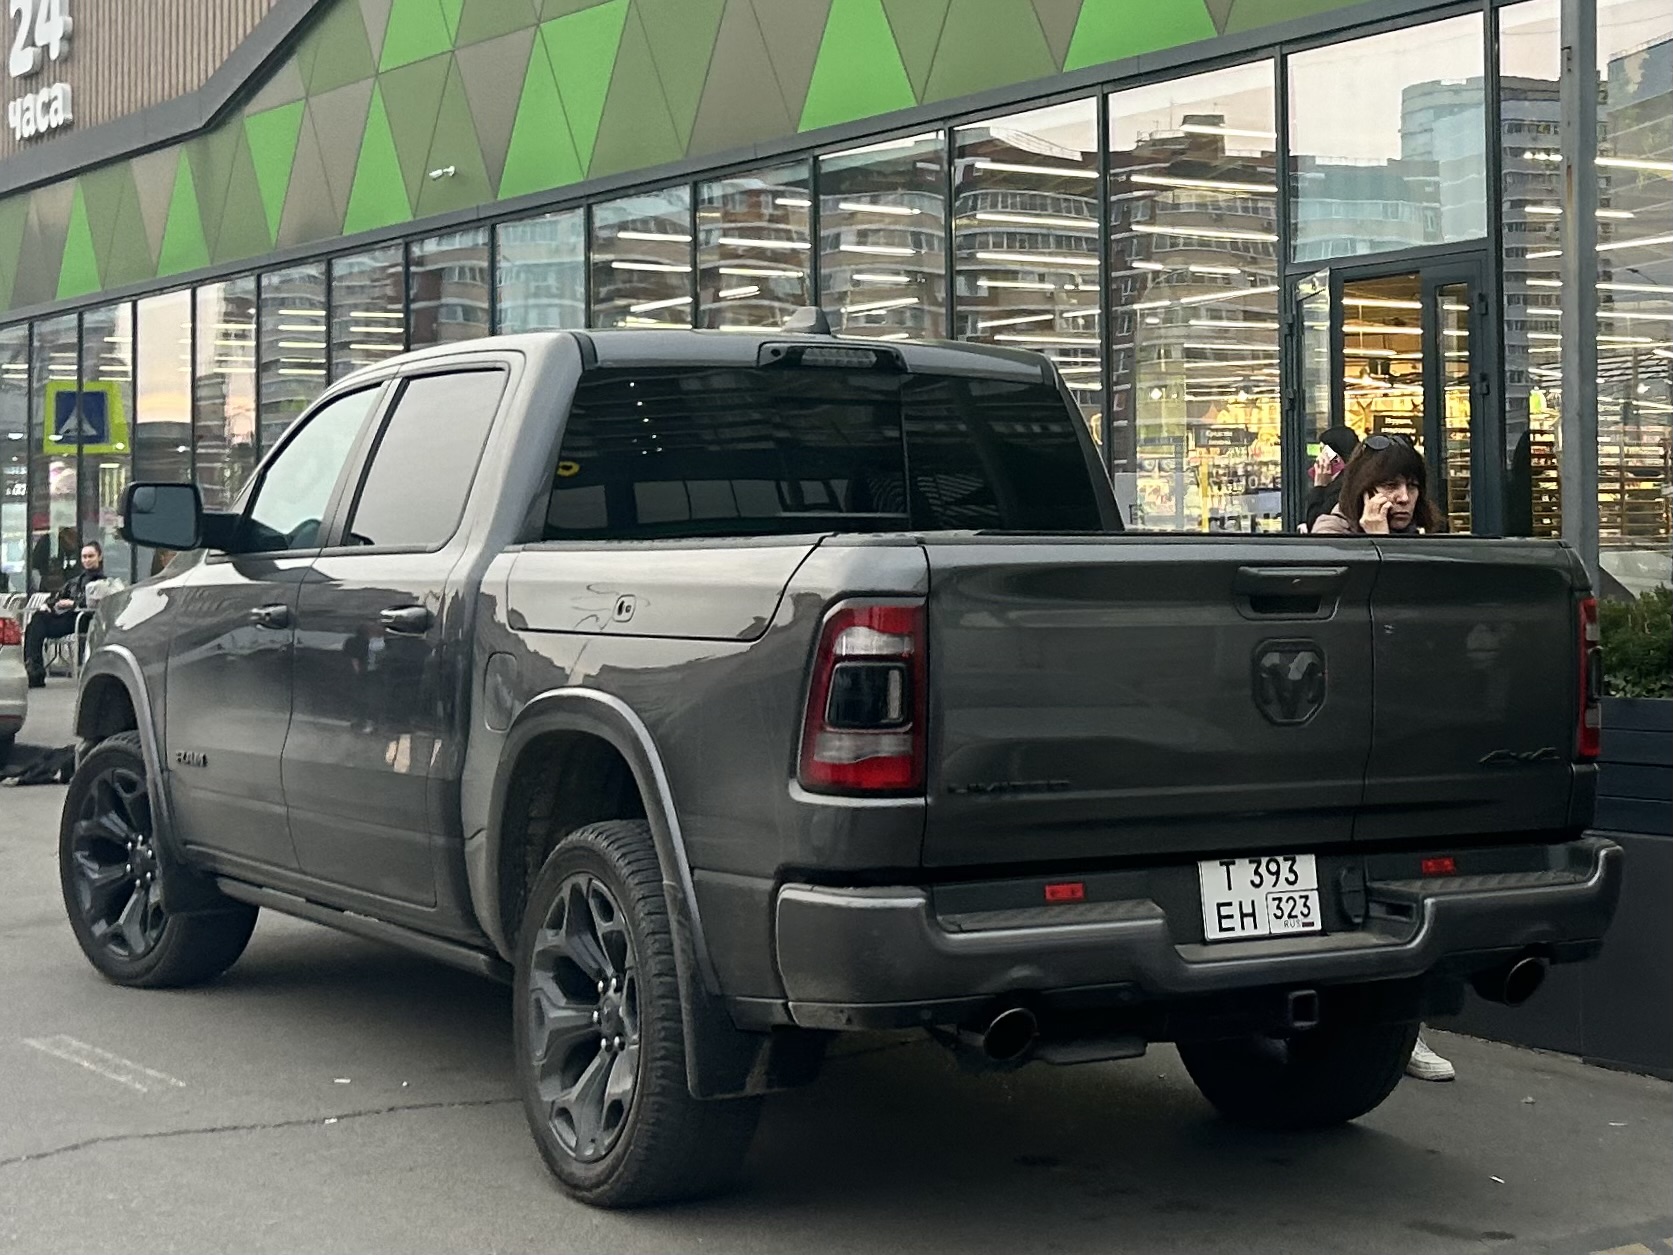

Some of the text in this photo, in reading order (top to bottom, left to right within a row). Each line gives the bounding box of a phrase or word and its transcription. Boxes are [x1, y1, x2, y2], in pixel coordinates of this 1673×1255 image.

[9, 0, 68, 78] 24
[8, 82, 68, 141] часа
[1248, 855, 1299, 889] 393
[1271, 894, 1311, 920] 323
[1283, 919, 1301, 928] RUS
